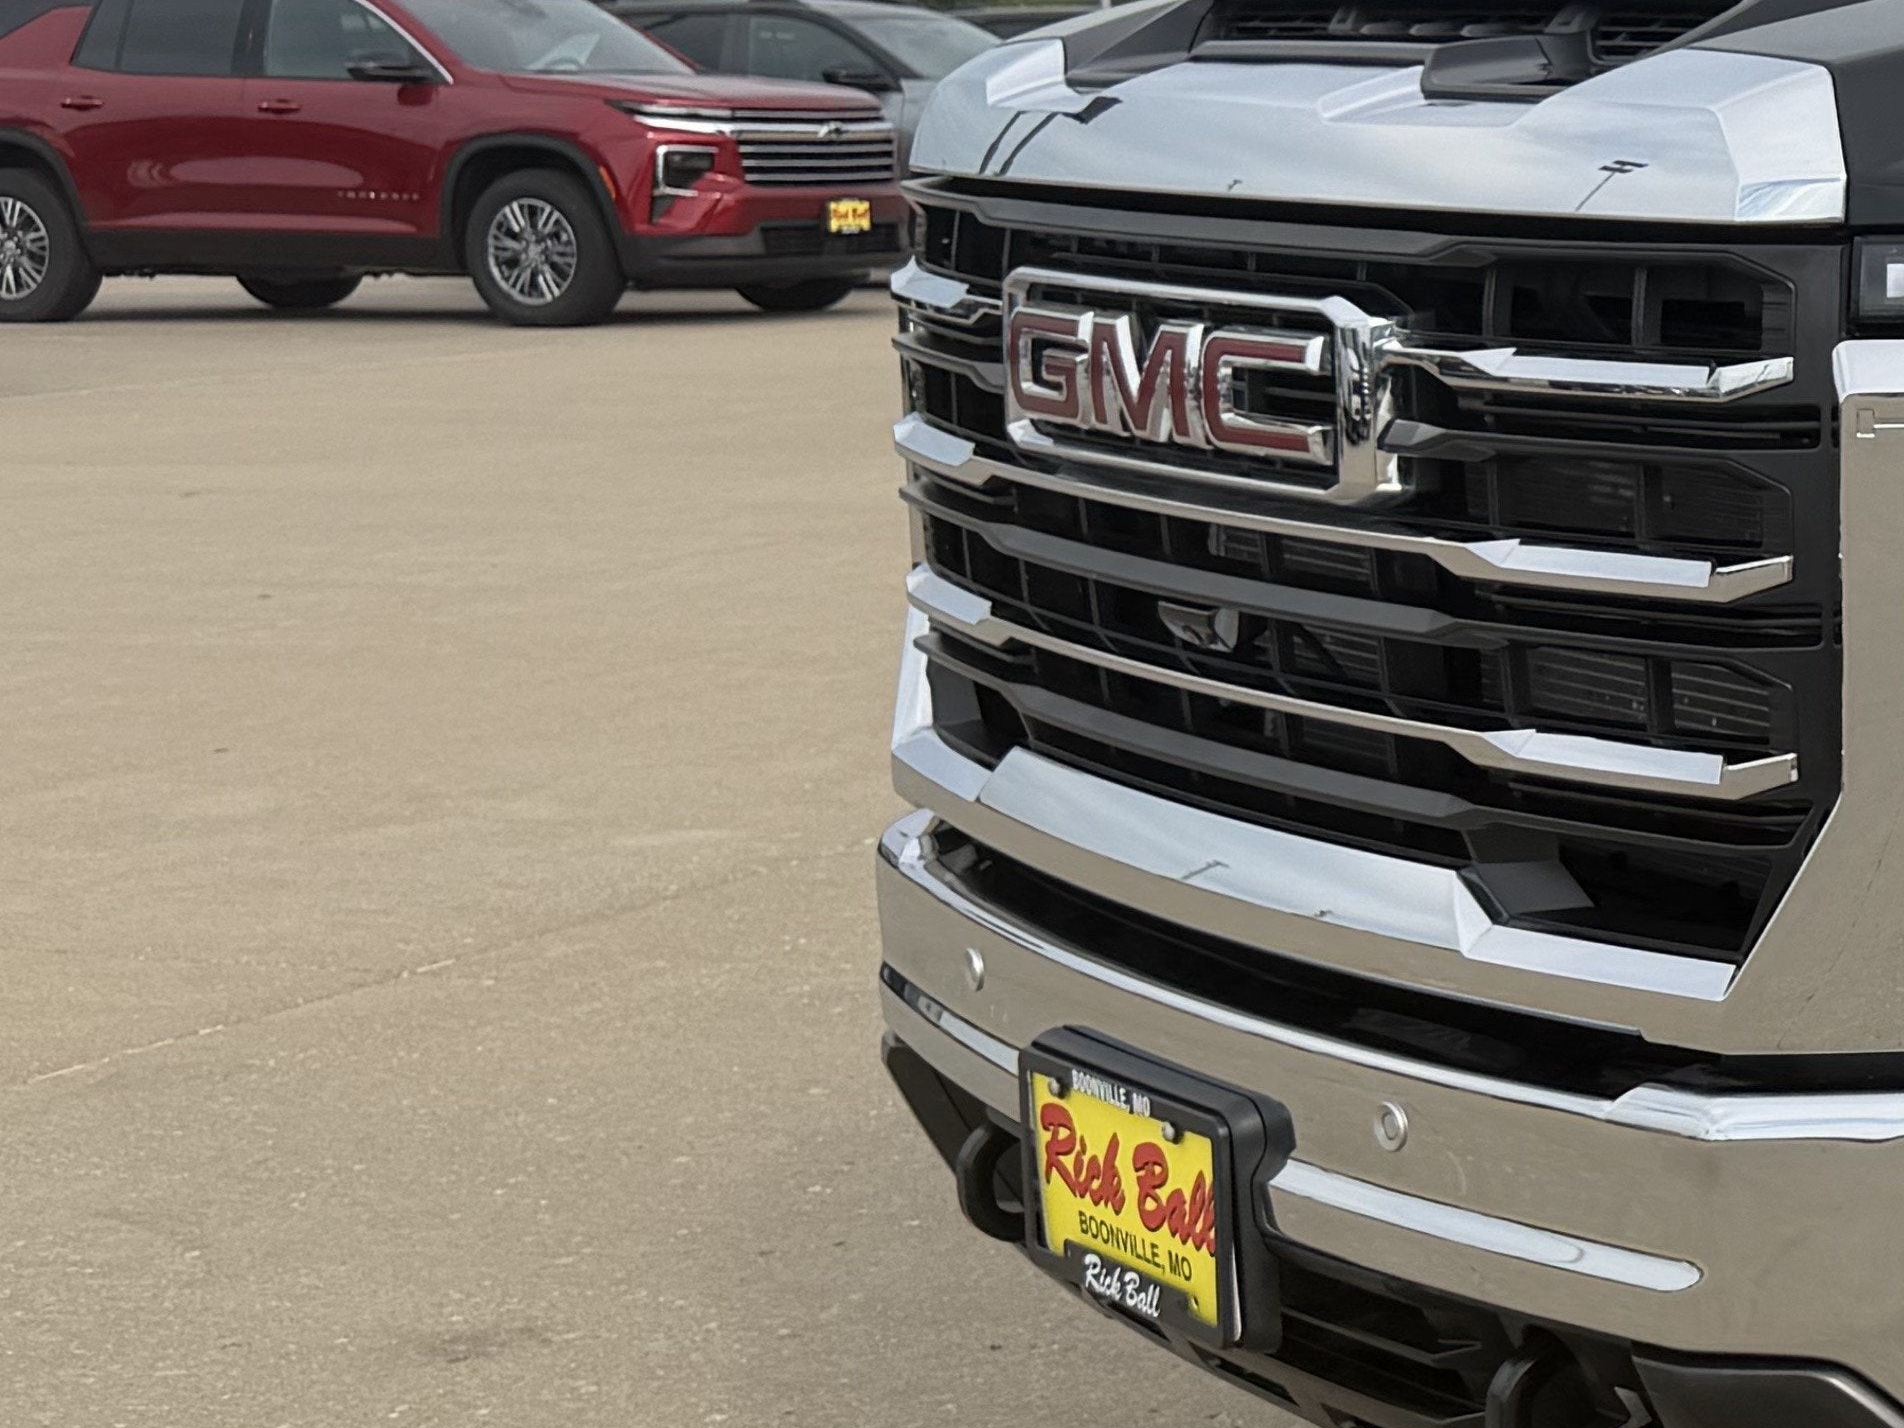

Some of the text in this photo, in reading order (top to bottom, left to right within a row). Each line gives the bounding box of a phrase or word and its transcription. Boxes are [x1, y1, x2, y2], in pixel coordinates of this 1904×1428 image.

[1009, 305, 1334, 465] GMC
[1071, 1069, 1151, 1117] BOONVILLE, MO
[1040, 1102, 1215, 1257] Rick Ball
[1078, 1210, 1193, 1282] BOONVILLE, MO
[1084, 1253, 1161, 1318] Rick Ball
